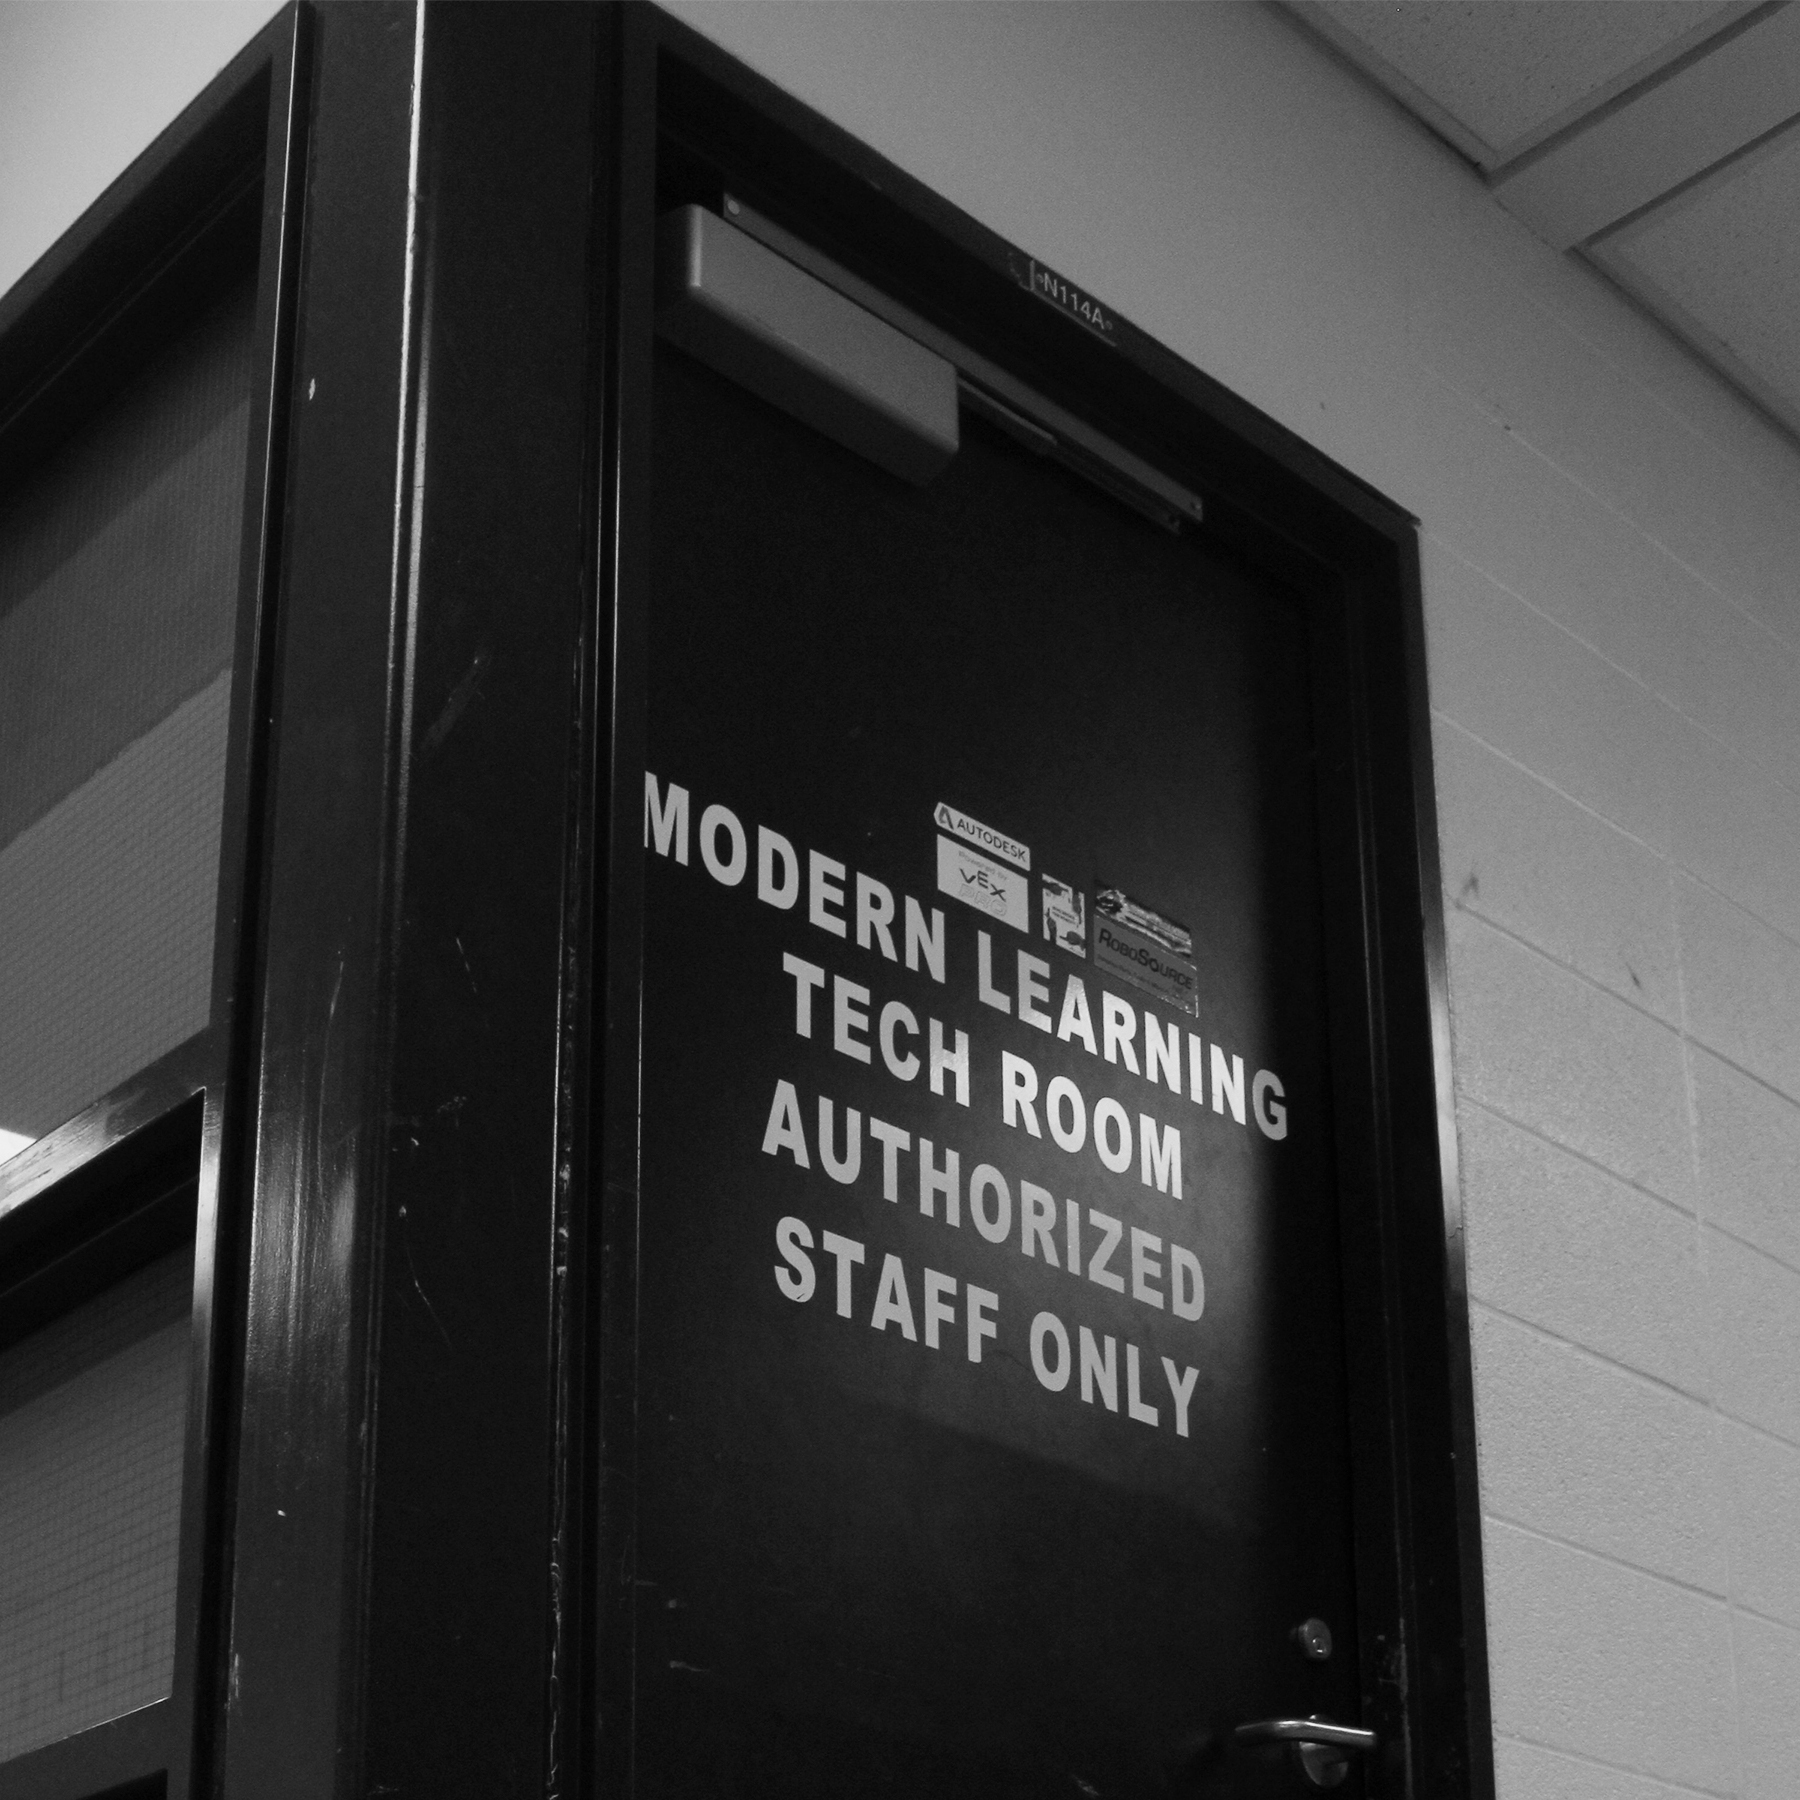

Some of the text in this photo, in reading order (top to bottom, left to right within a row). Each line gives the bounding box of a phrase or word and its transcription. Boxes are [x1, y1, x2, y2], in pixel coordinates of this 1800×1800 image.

[1044, 272, 1105, 330] N114A
[957, 818, 1027, 862] AUTODESK
[959, 883, 1007, 917] PRO
[644, 771, 1287, 1140] MODERN LEARNING
[783, 952, 1182, 1200] TECH ROOM
[762, 1079, 1206, 1321] AUTHORIZED
[774, 1216, 1200, 1438] STAFF ONLY
